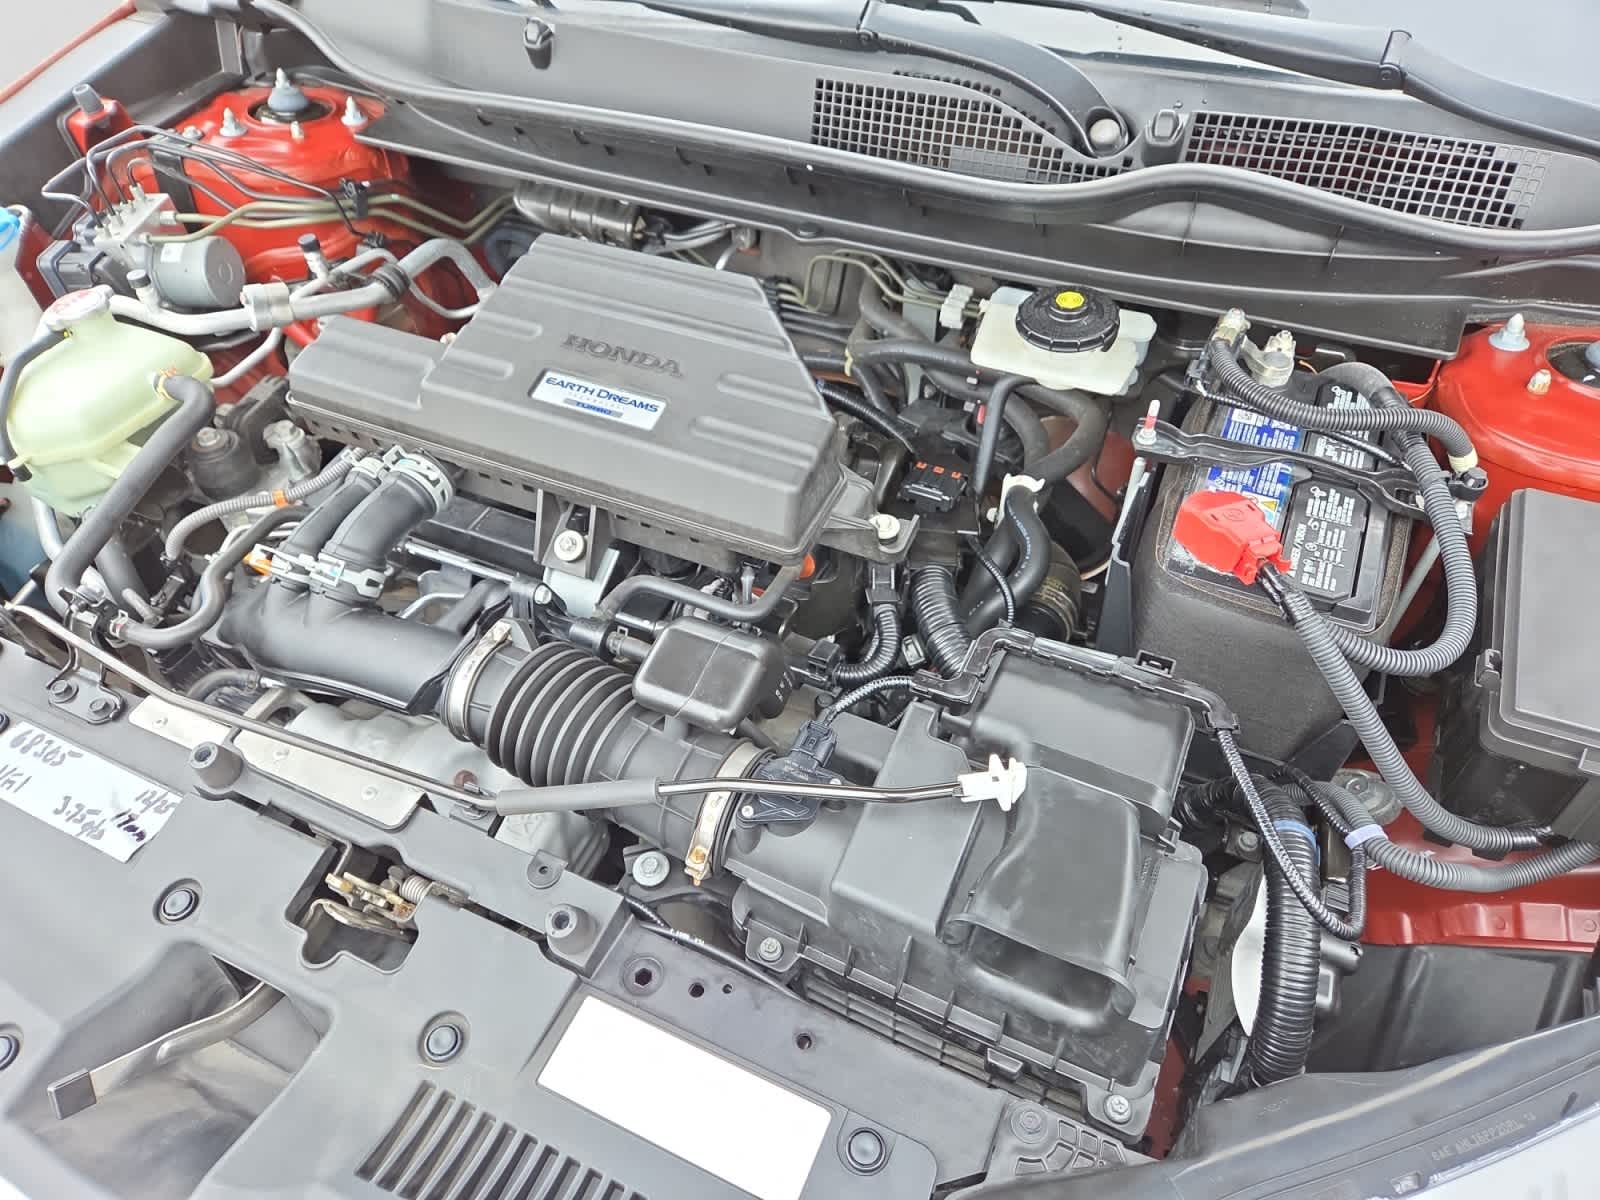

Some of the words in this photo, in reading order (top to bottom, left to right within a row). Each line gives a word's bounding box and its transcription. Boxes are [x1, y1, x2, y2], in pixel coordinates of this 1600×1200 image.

[561, 334, 683, 378] HONDA
[545, 377, 595, 397] EARTH
[597, 388, 660, 413] DREAMS
